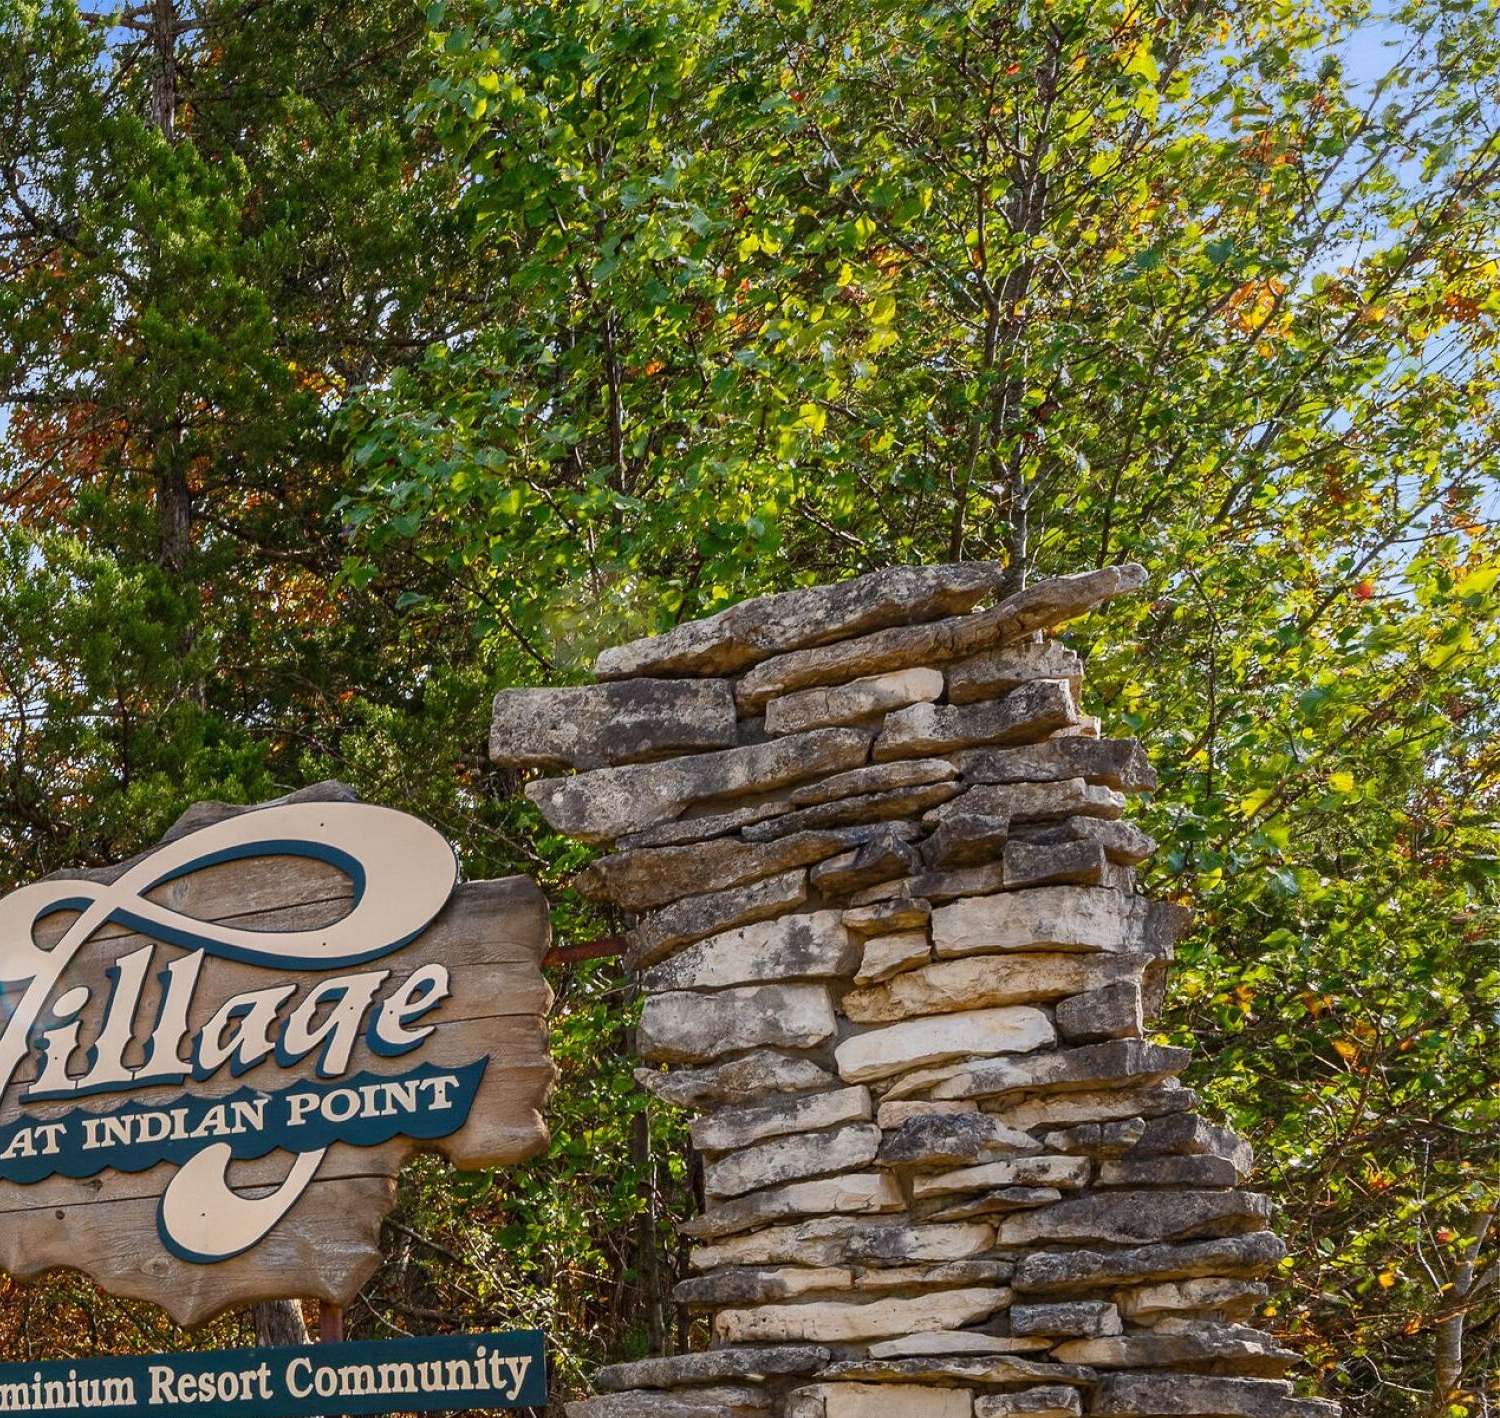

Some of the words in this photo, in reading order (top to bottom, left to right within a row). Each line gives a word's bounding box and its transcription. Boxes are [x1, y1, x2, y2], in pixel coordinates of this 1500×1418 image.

[0, 1122, 67, 1160] AT
[81, 1098, 269, 1150] INDIAN
[285, 1074, 460, 1126] POINT
[147, 1361, 274, 1405] Resort
[285, 1344, 533, 1401] Community
